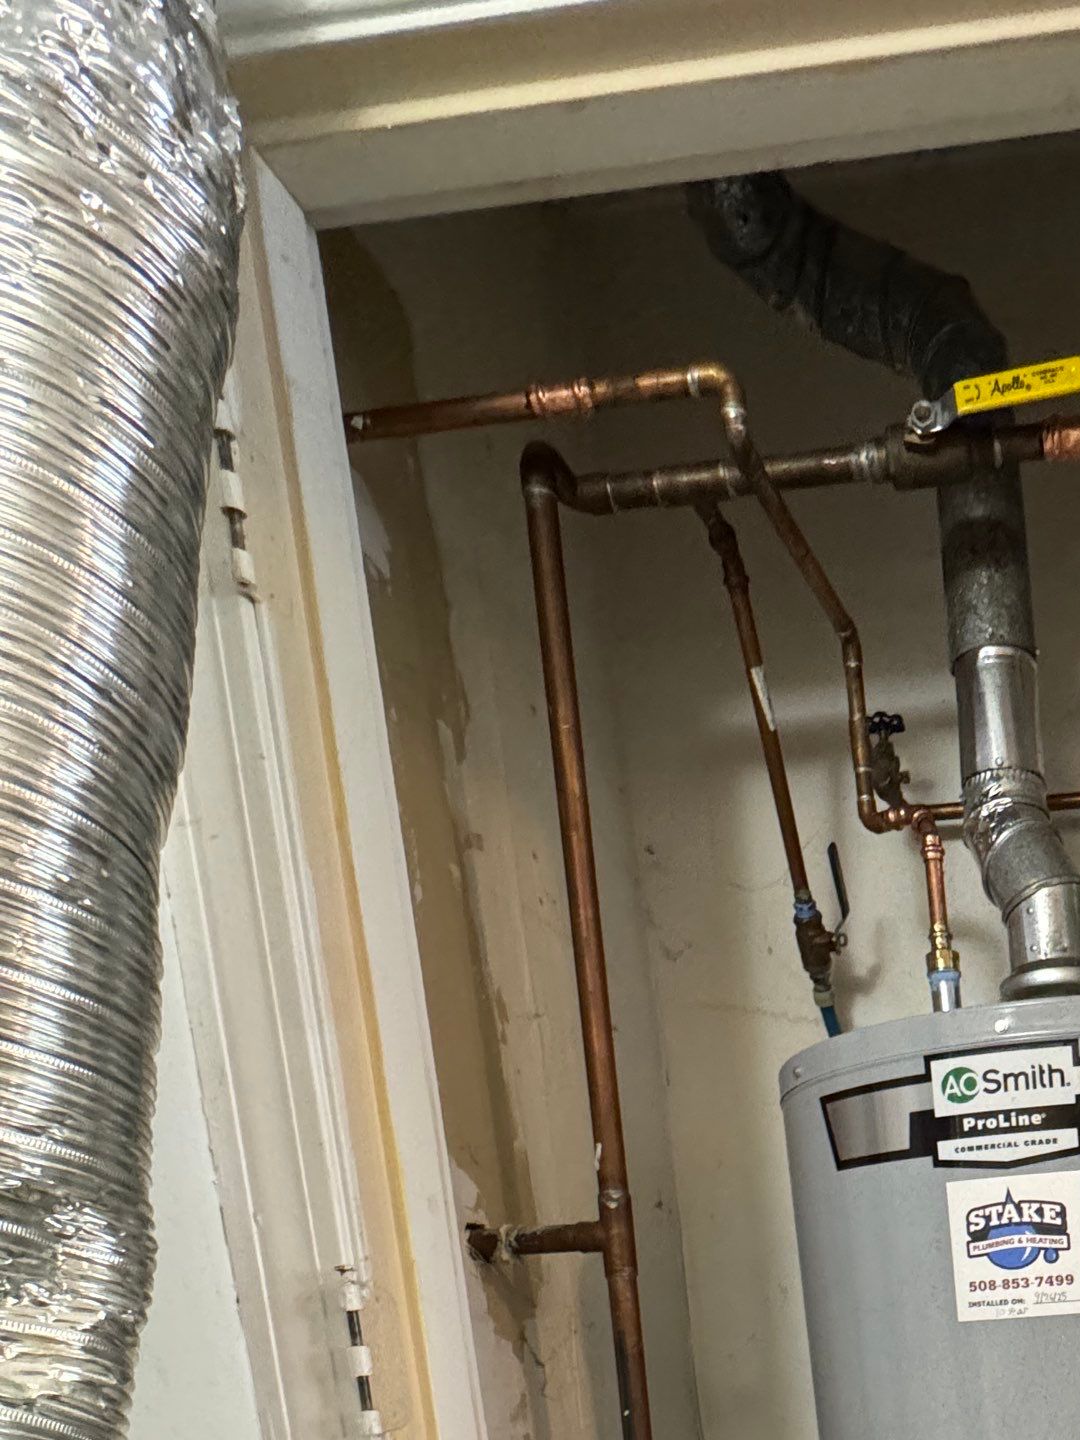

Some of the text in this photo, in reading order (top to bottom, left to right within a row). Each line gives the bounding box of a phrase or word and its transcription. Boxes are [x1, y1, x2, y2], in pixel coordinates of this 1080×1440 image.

[954, 1137, 1058, 1154] COMMERCIAL GRADE
[968, 1202, 1063, 1233] STAKE
[972, 1237, 1015, 1252] PLUMBING
[1026, 1237, 1064, 1246] HEATING
[969, 1273, 1075, 1293] 508-853-7499
[968, 1298, 1009, 1309] INSTALLED
